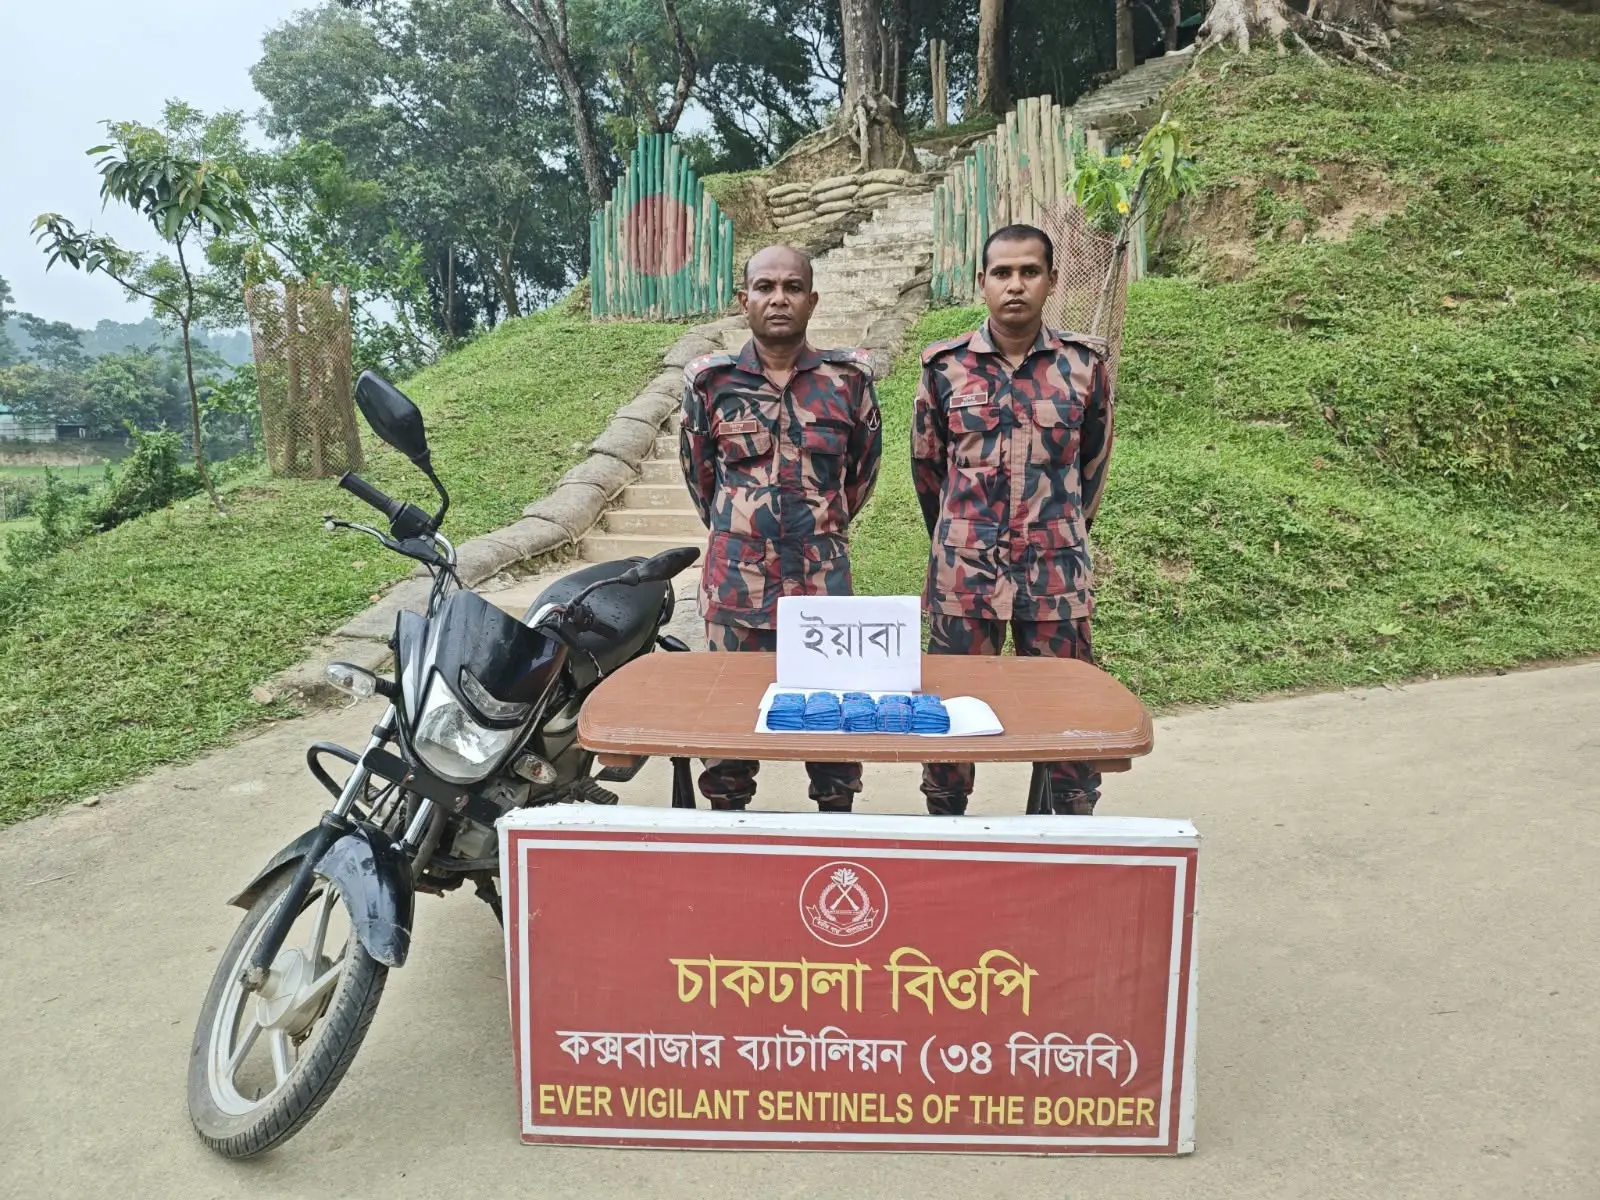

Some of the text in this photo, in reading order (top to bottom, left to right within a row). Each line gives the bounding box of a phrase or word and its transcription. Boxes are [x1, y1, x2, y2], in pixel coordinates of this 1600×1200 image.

[800, 611, 907, 658] ইয়াবা
[668, 946, 1039, 1016] চাকঢালা বিওপি
[556, 1024, 1139, 1088] কক্সবাজার ব্যাটালিয়ন (৩৪ বিজিবি)
[538, 1084, 1156, 1129] EVER VIGILANT SENTINELS OF THE BORDER
